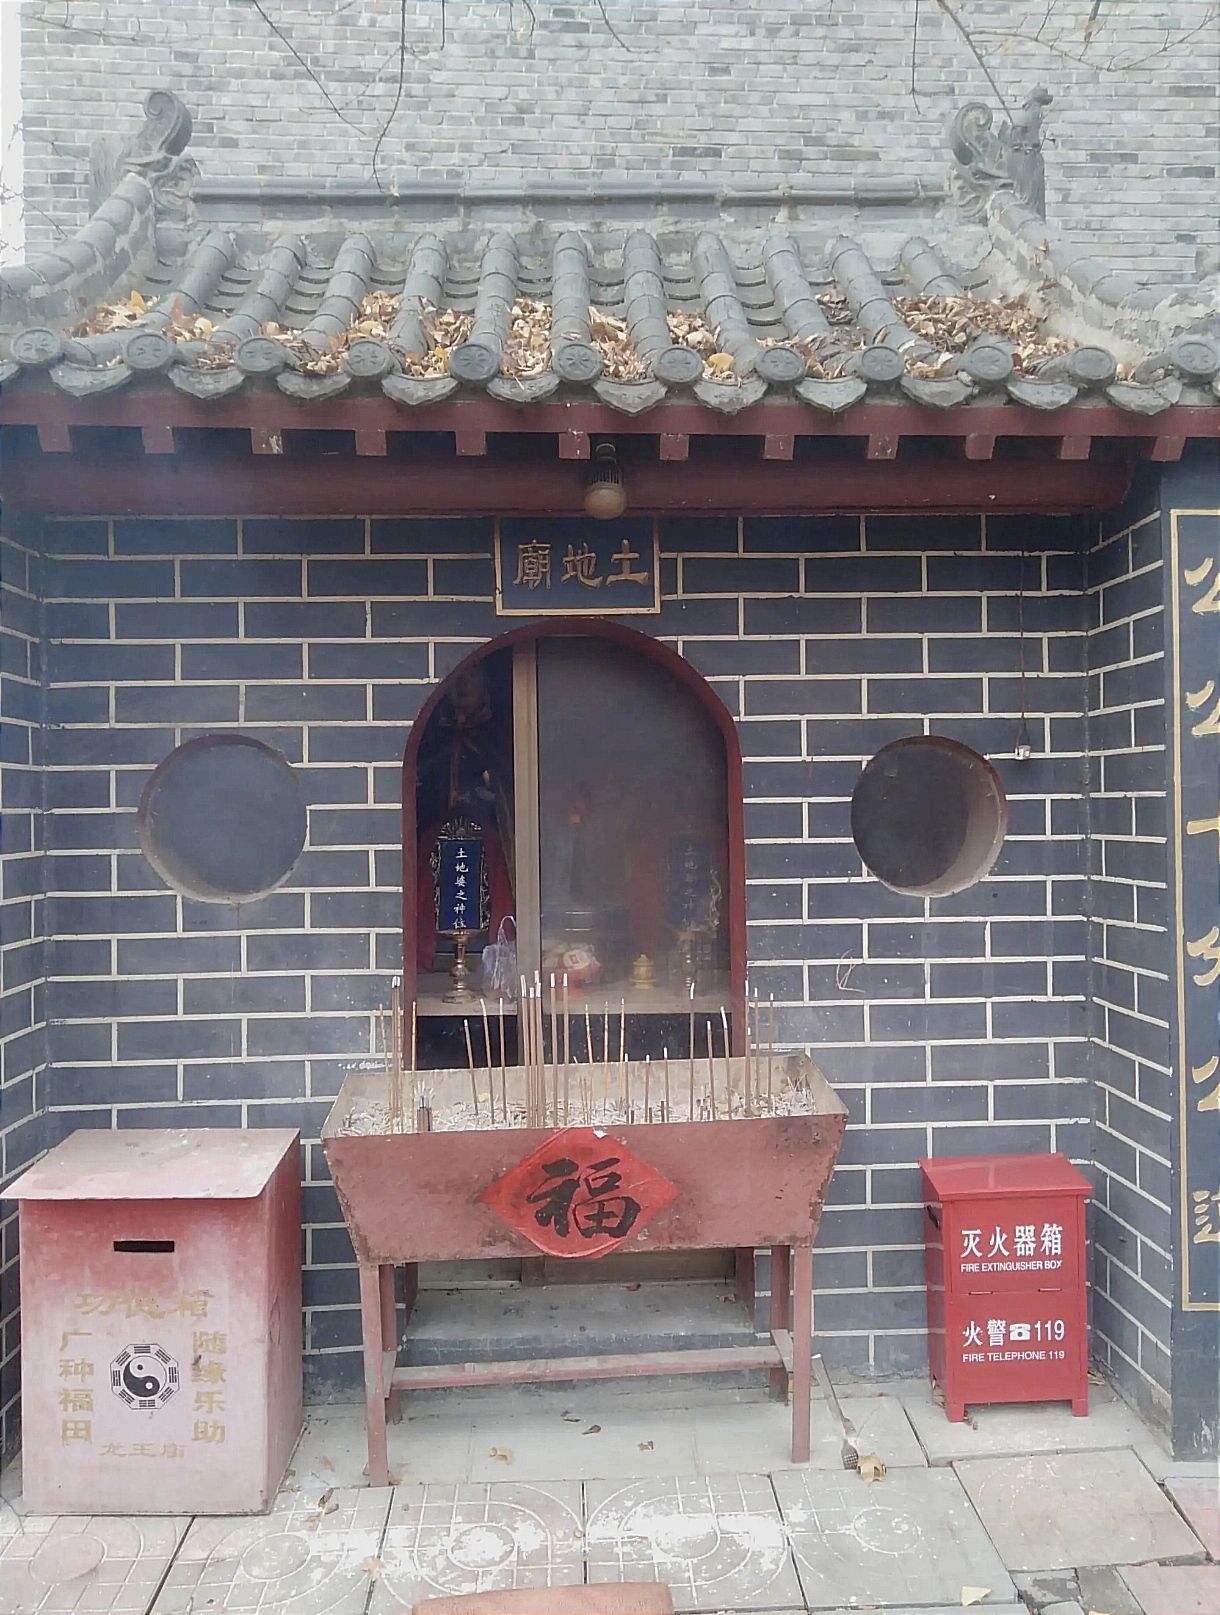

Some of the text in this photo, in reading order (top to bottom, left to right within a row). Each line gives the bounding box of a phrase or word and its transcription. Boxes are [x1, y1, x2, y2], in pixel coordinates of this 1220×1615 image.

[513, 539, 649, 590] 土地廟
[526, 1157, 641, 1238] 福
[960, 1223, 1063, 1258] 灭火器箱
[961, 1260, 1063, 1272] FIRE EXTINGUISHER BOX
[1034, 1319, 1065, 1342] 119
[962, 1350, 1065, 1363] FIRE TELEPHONE 119
[58, 1331, 94, 1444] 广种福田
[191, 1331, 227, 1444] 随缘乐助
